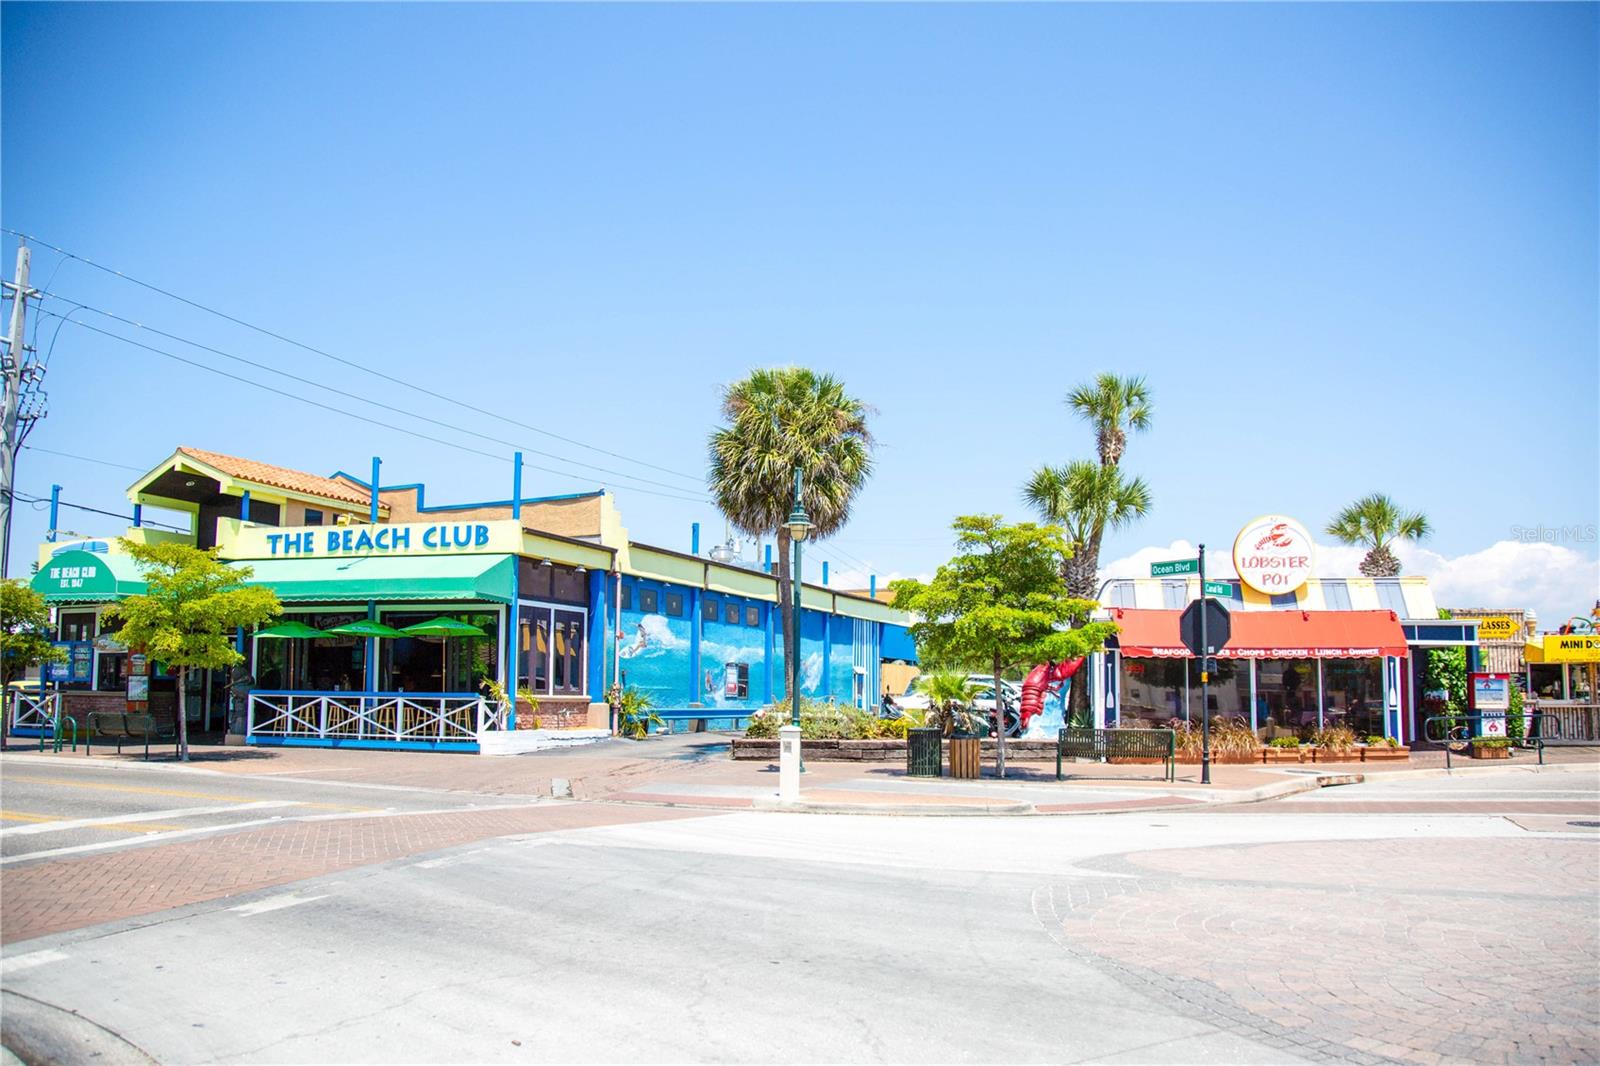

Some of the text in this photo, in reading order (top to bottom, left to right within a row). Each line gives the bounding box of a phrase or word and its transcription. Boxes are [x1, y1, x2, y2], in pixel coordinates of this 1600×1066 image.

[266, 525, 489, 554] THE BEACH CLUB
[1242, 555, 1309, 568] LOBSTER
[1152, 562, 1190, 574] Ocean Blvd
[1262, 573, 1290, 586] POT
[1478, 620, 1511, 630] LASSES
[1560, 640, 1583, 649] MINI
[1152, 647, 1191, 656] SEAFOOD
[1237, 648, 1265, 656] CHOPS
[1272, 648, 1308, 656] CHICKEN
[1315, 648, 1342, 656] LUNCH
